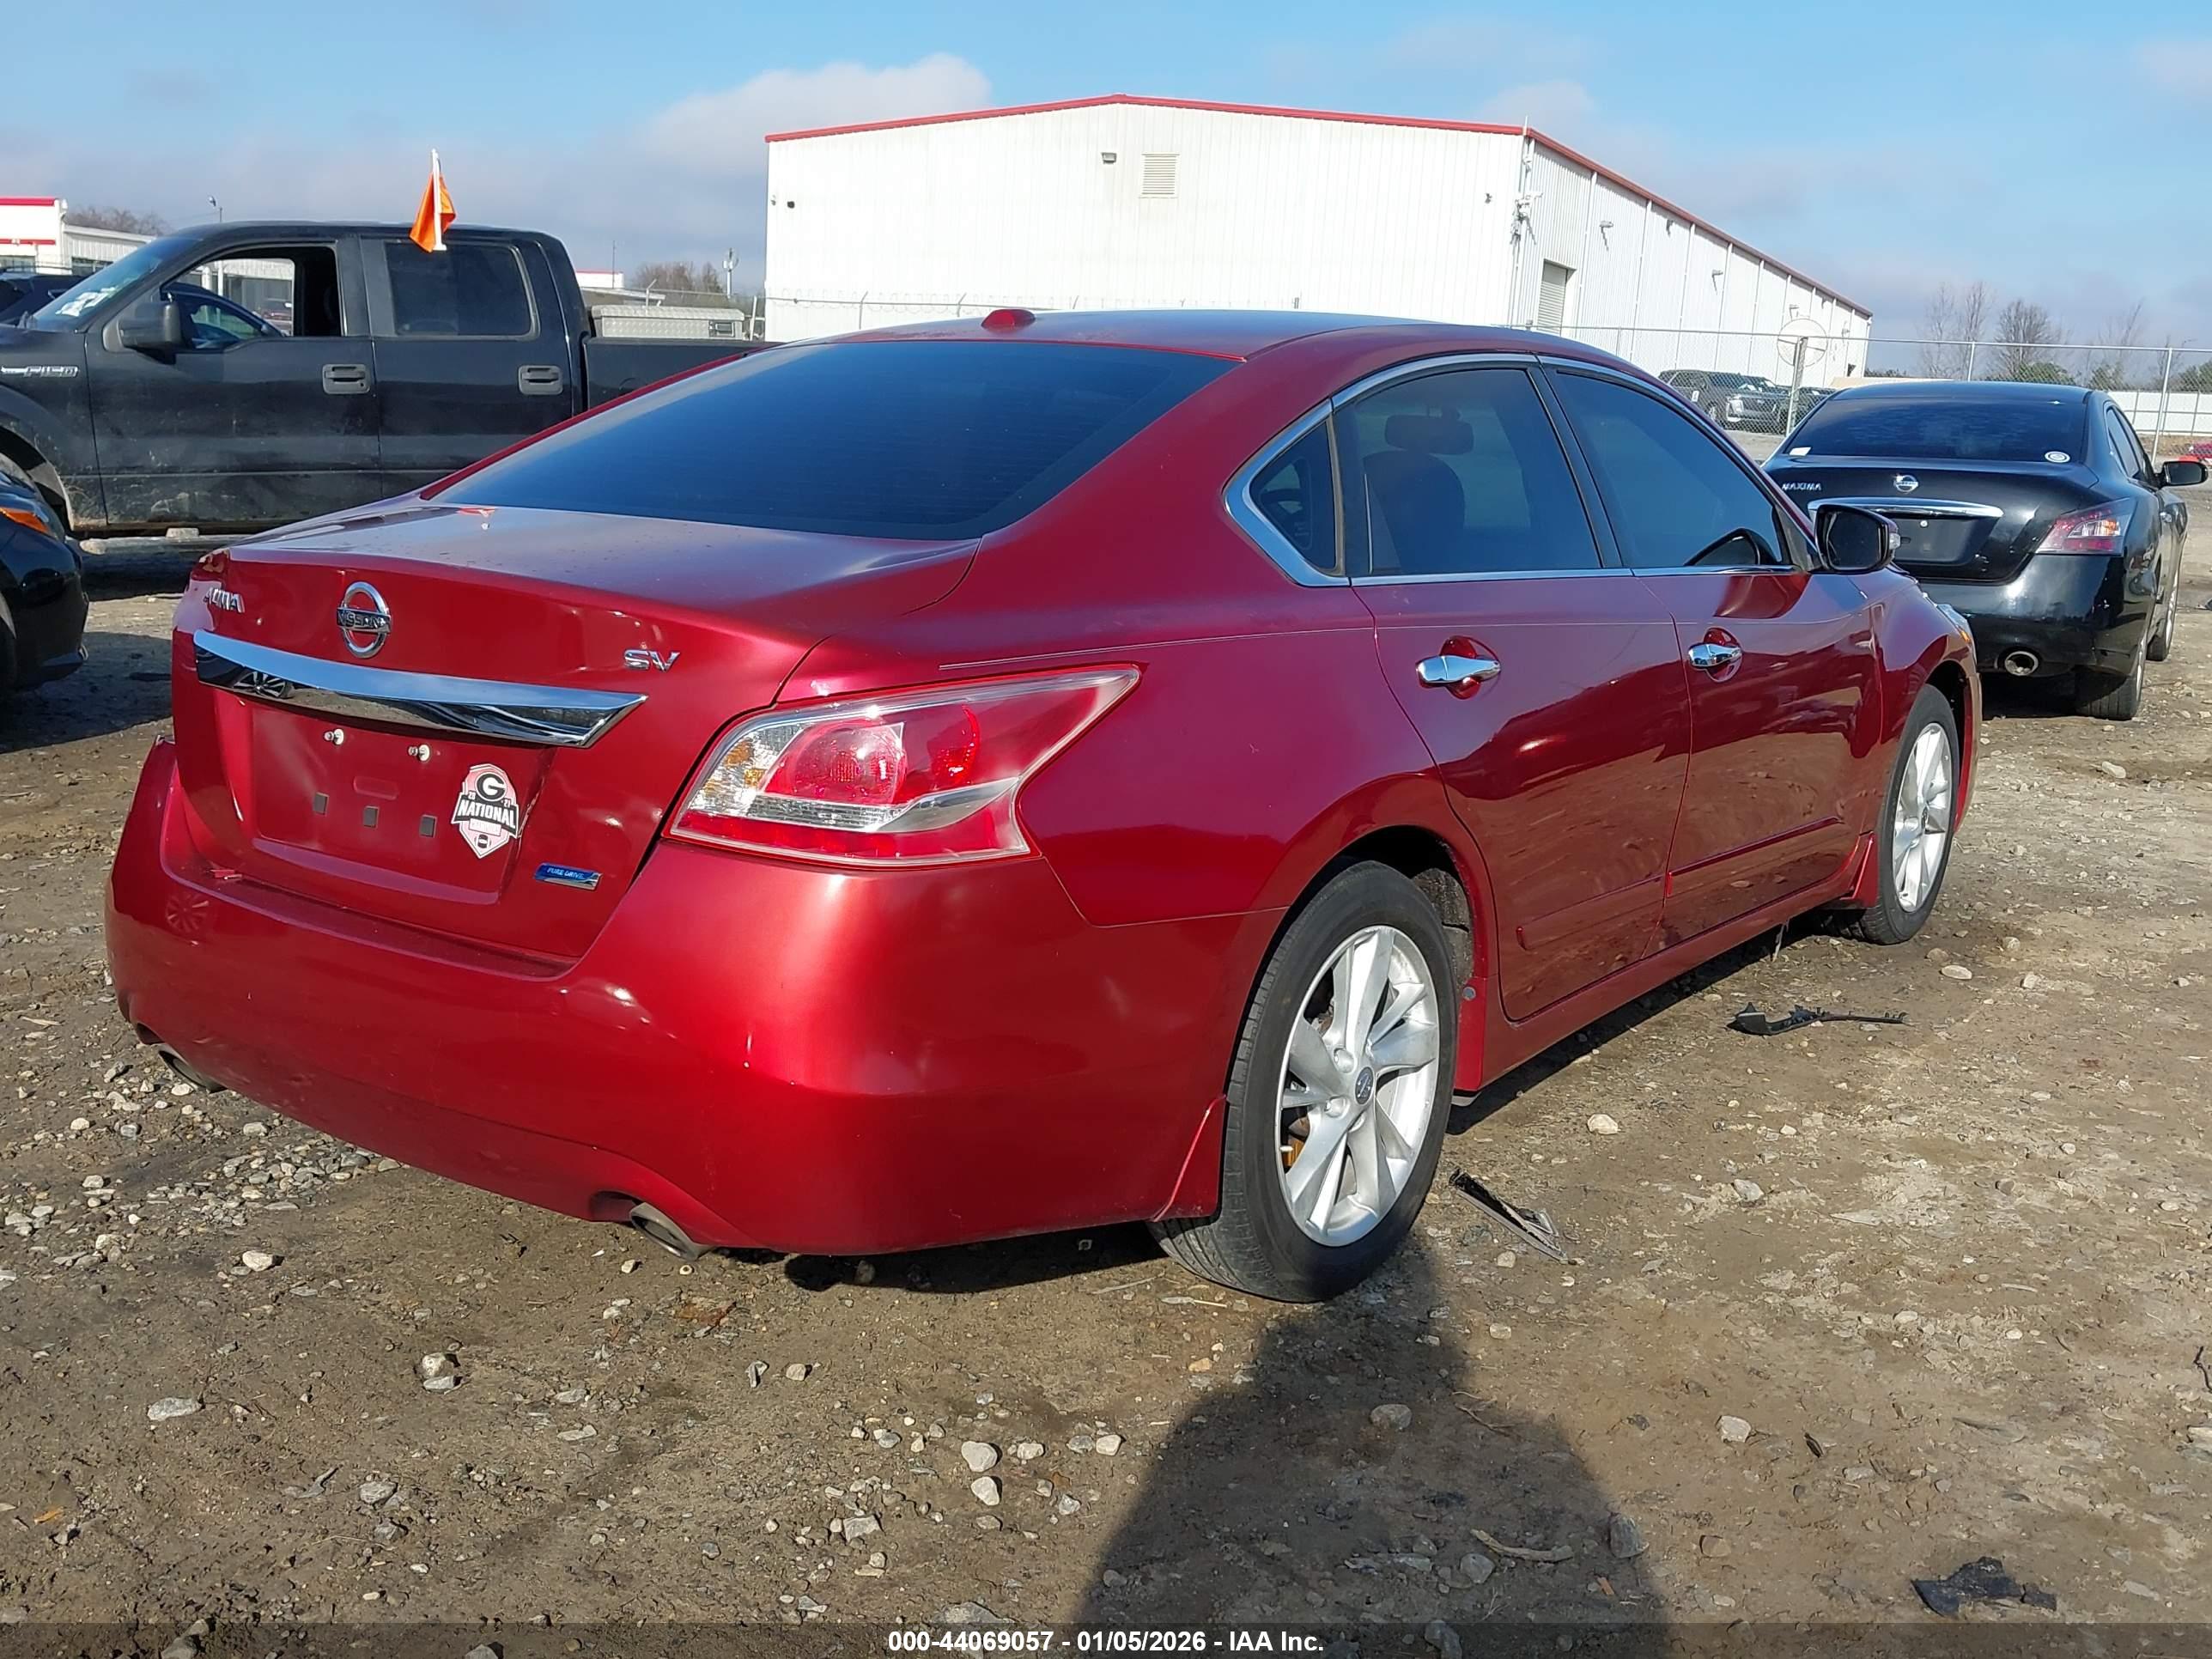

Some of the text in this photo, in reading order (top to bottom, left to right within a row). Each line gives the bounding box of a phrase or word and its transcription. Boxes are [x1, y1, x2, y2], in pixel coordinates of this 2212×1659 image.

[1782, 482, 1822, 491] MAXIMA
[624, 649, 681, 672] SV
[457, 799, 516, 830] NATIONAL
[547, 866, 585, 879] PURE DRIVE
